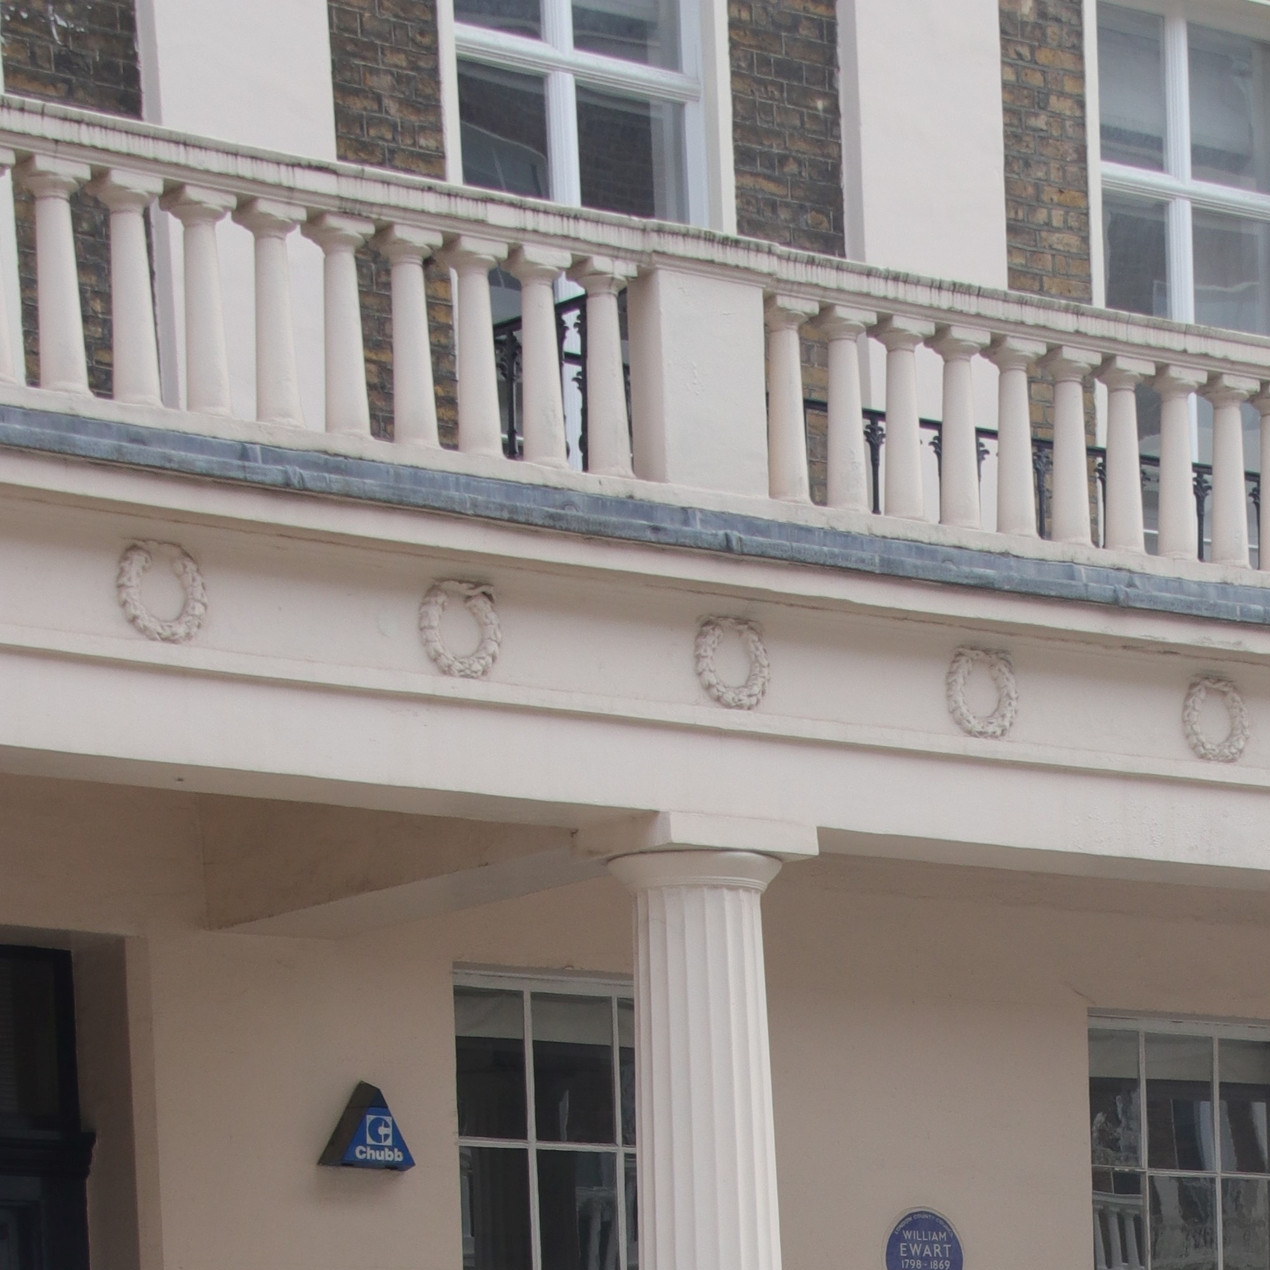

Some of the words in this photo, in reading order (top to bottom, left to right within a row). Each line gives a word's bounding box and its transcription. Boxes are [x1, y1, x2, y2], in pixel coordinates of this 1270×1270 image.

[355, 1145, 404, 1162] Chubb
[894, 1217, 912, 1235] LONDON
[902, 1230, 947, 1241] WILLIAM
[900, 1243, 951, 1258] EWART
[901, 1259, 922, 1269] 1798
[930, 1260, 950, 1270] 1869
